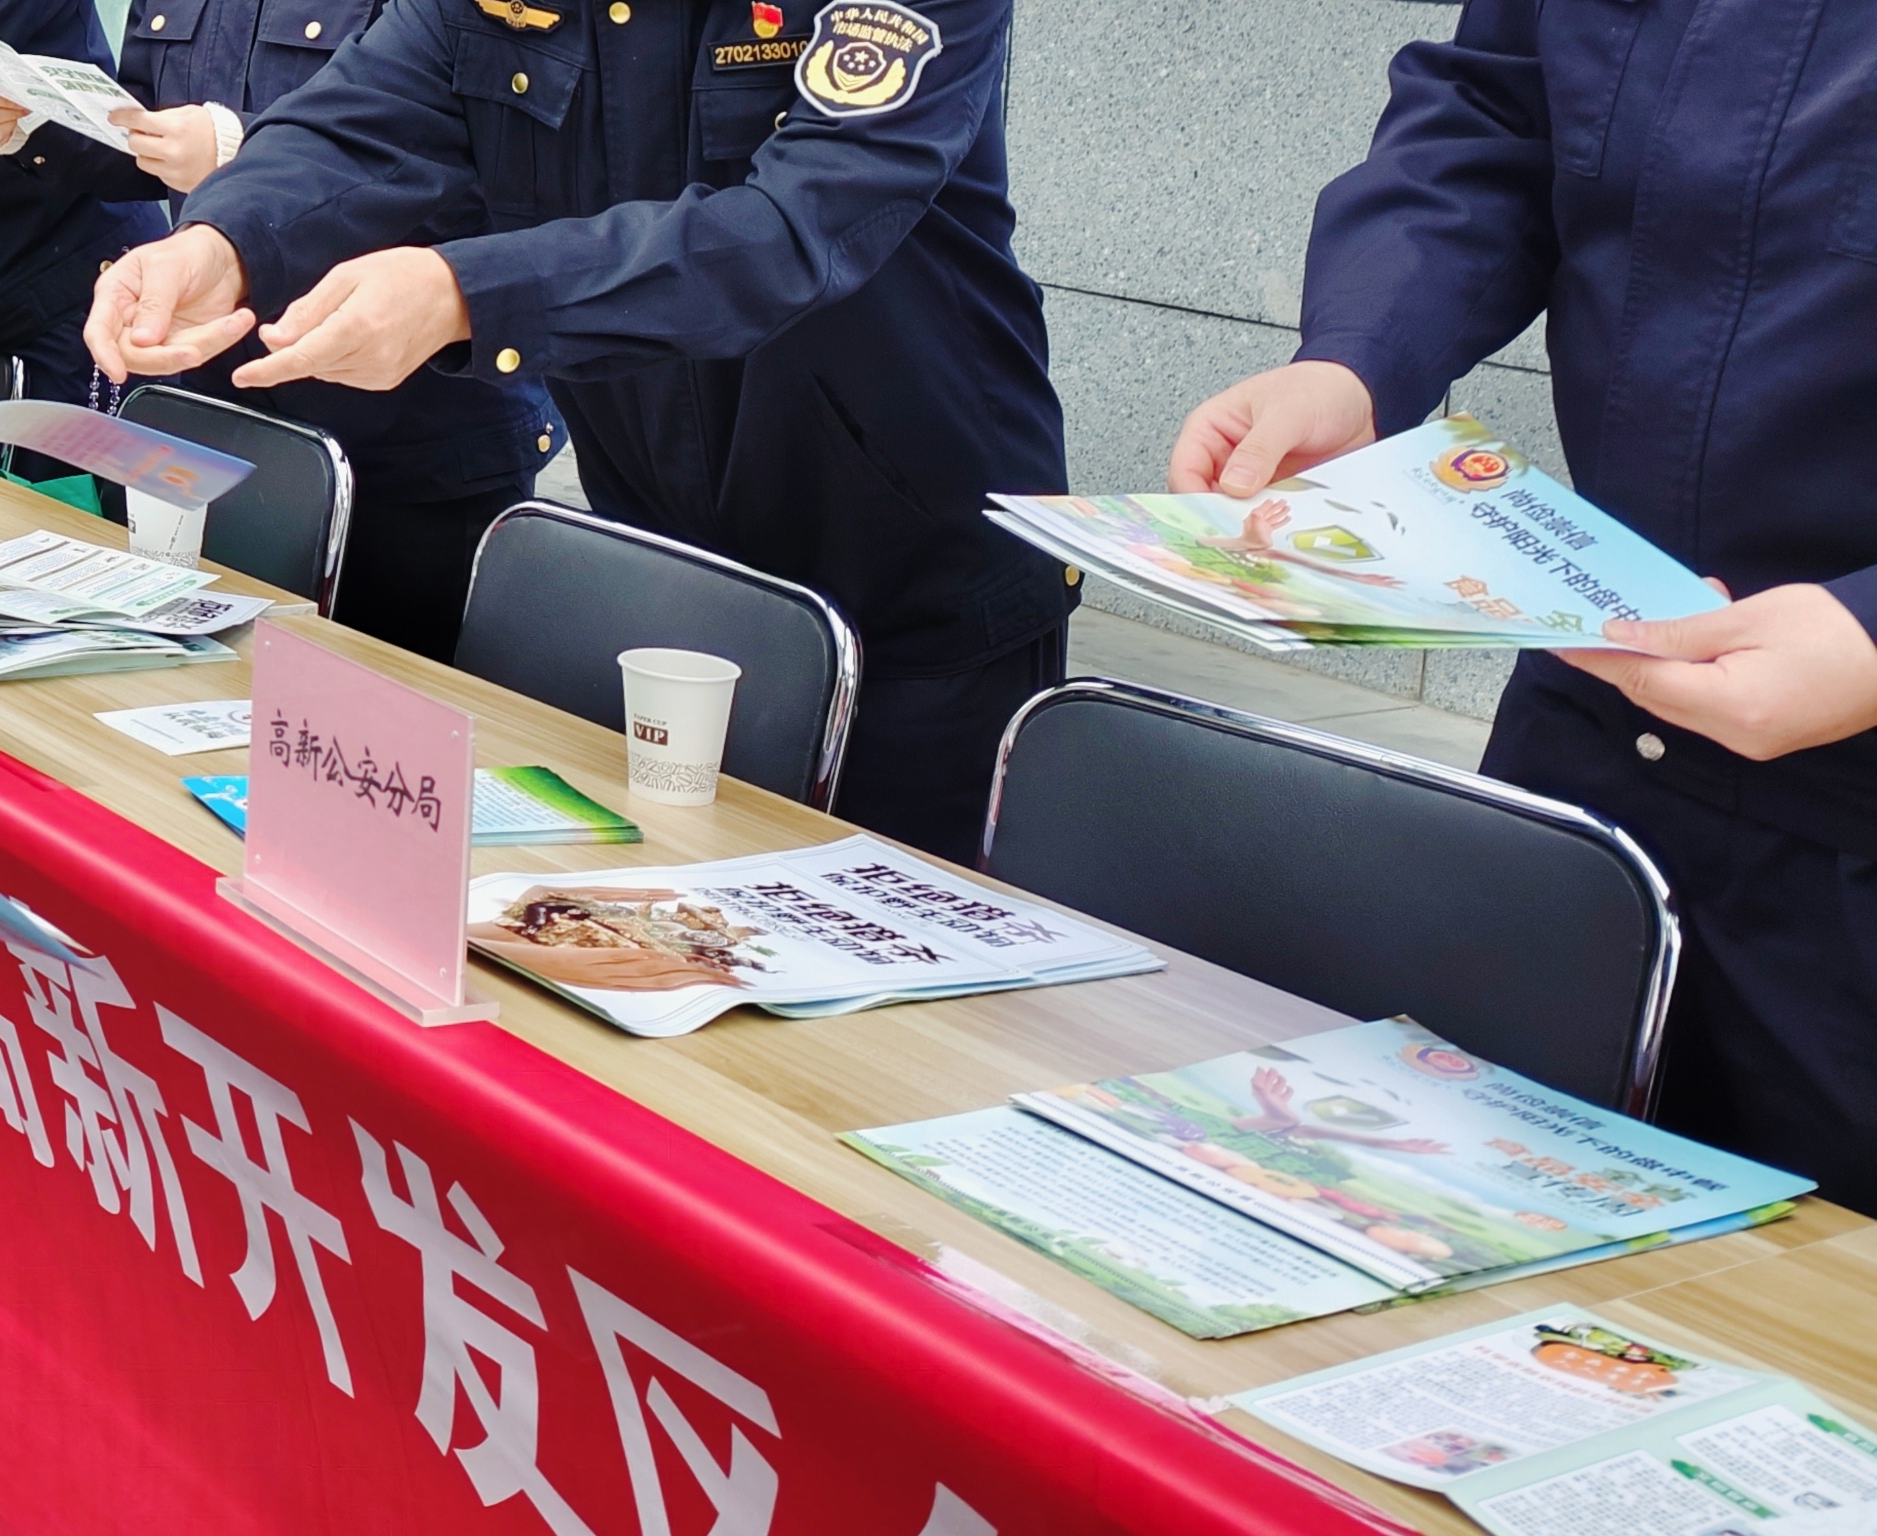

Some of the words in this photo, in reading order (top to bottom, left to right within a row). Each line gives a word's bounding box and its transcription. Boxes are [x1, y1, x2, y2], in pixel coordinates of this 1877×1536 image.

[830, 7, 929, 45] 中华人民共和国
[832, 21, 913, 53] 市场监管执法
[633, 713, 652, 724] PAPER
[653, 718, 667, 726] CUP
[635, 723, 666, 743] VIP
[269, 708, 442, 832] 高新公安分局
